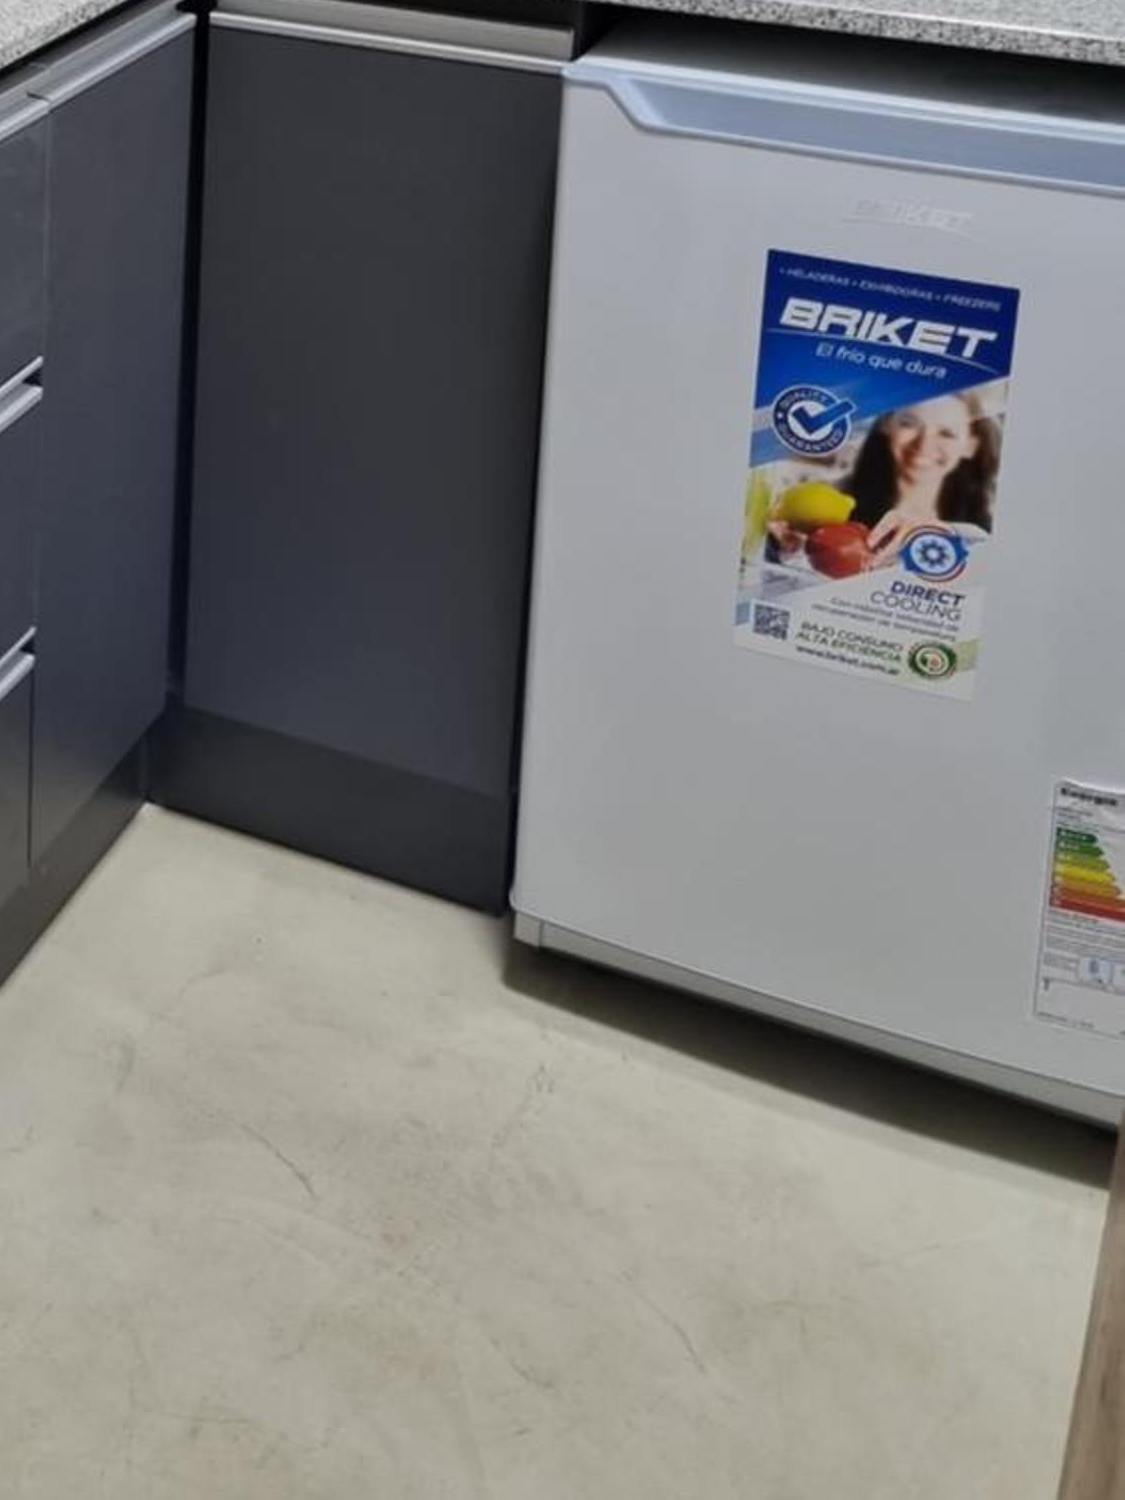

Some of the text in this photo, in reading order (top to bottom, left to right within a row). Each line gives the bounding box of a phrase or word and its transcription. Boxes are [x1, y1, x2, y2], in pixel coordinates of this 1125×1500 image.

[779, 297, 998, 359] BRIKET
[816, 342, 832, 358] El
[868, 355, 902, 373] que
[906, 358, 947, 379] dura
[870, 591, 960, 621] COOLING
[891, 581, 966, 605] DIRECT
[797, 631, 829, 644] ALTA
[801, 622, 905, 652] BAJO CONSUMO
